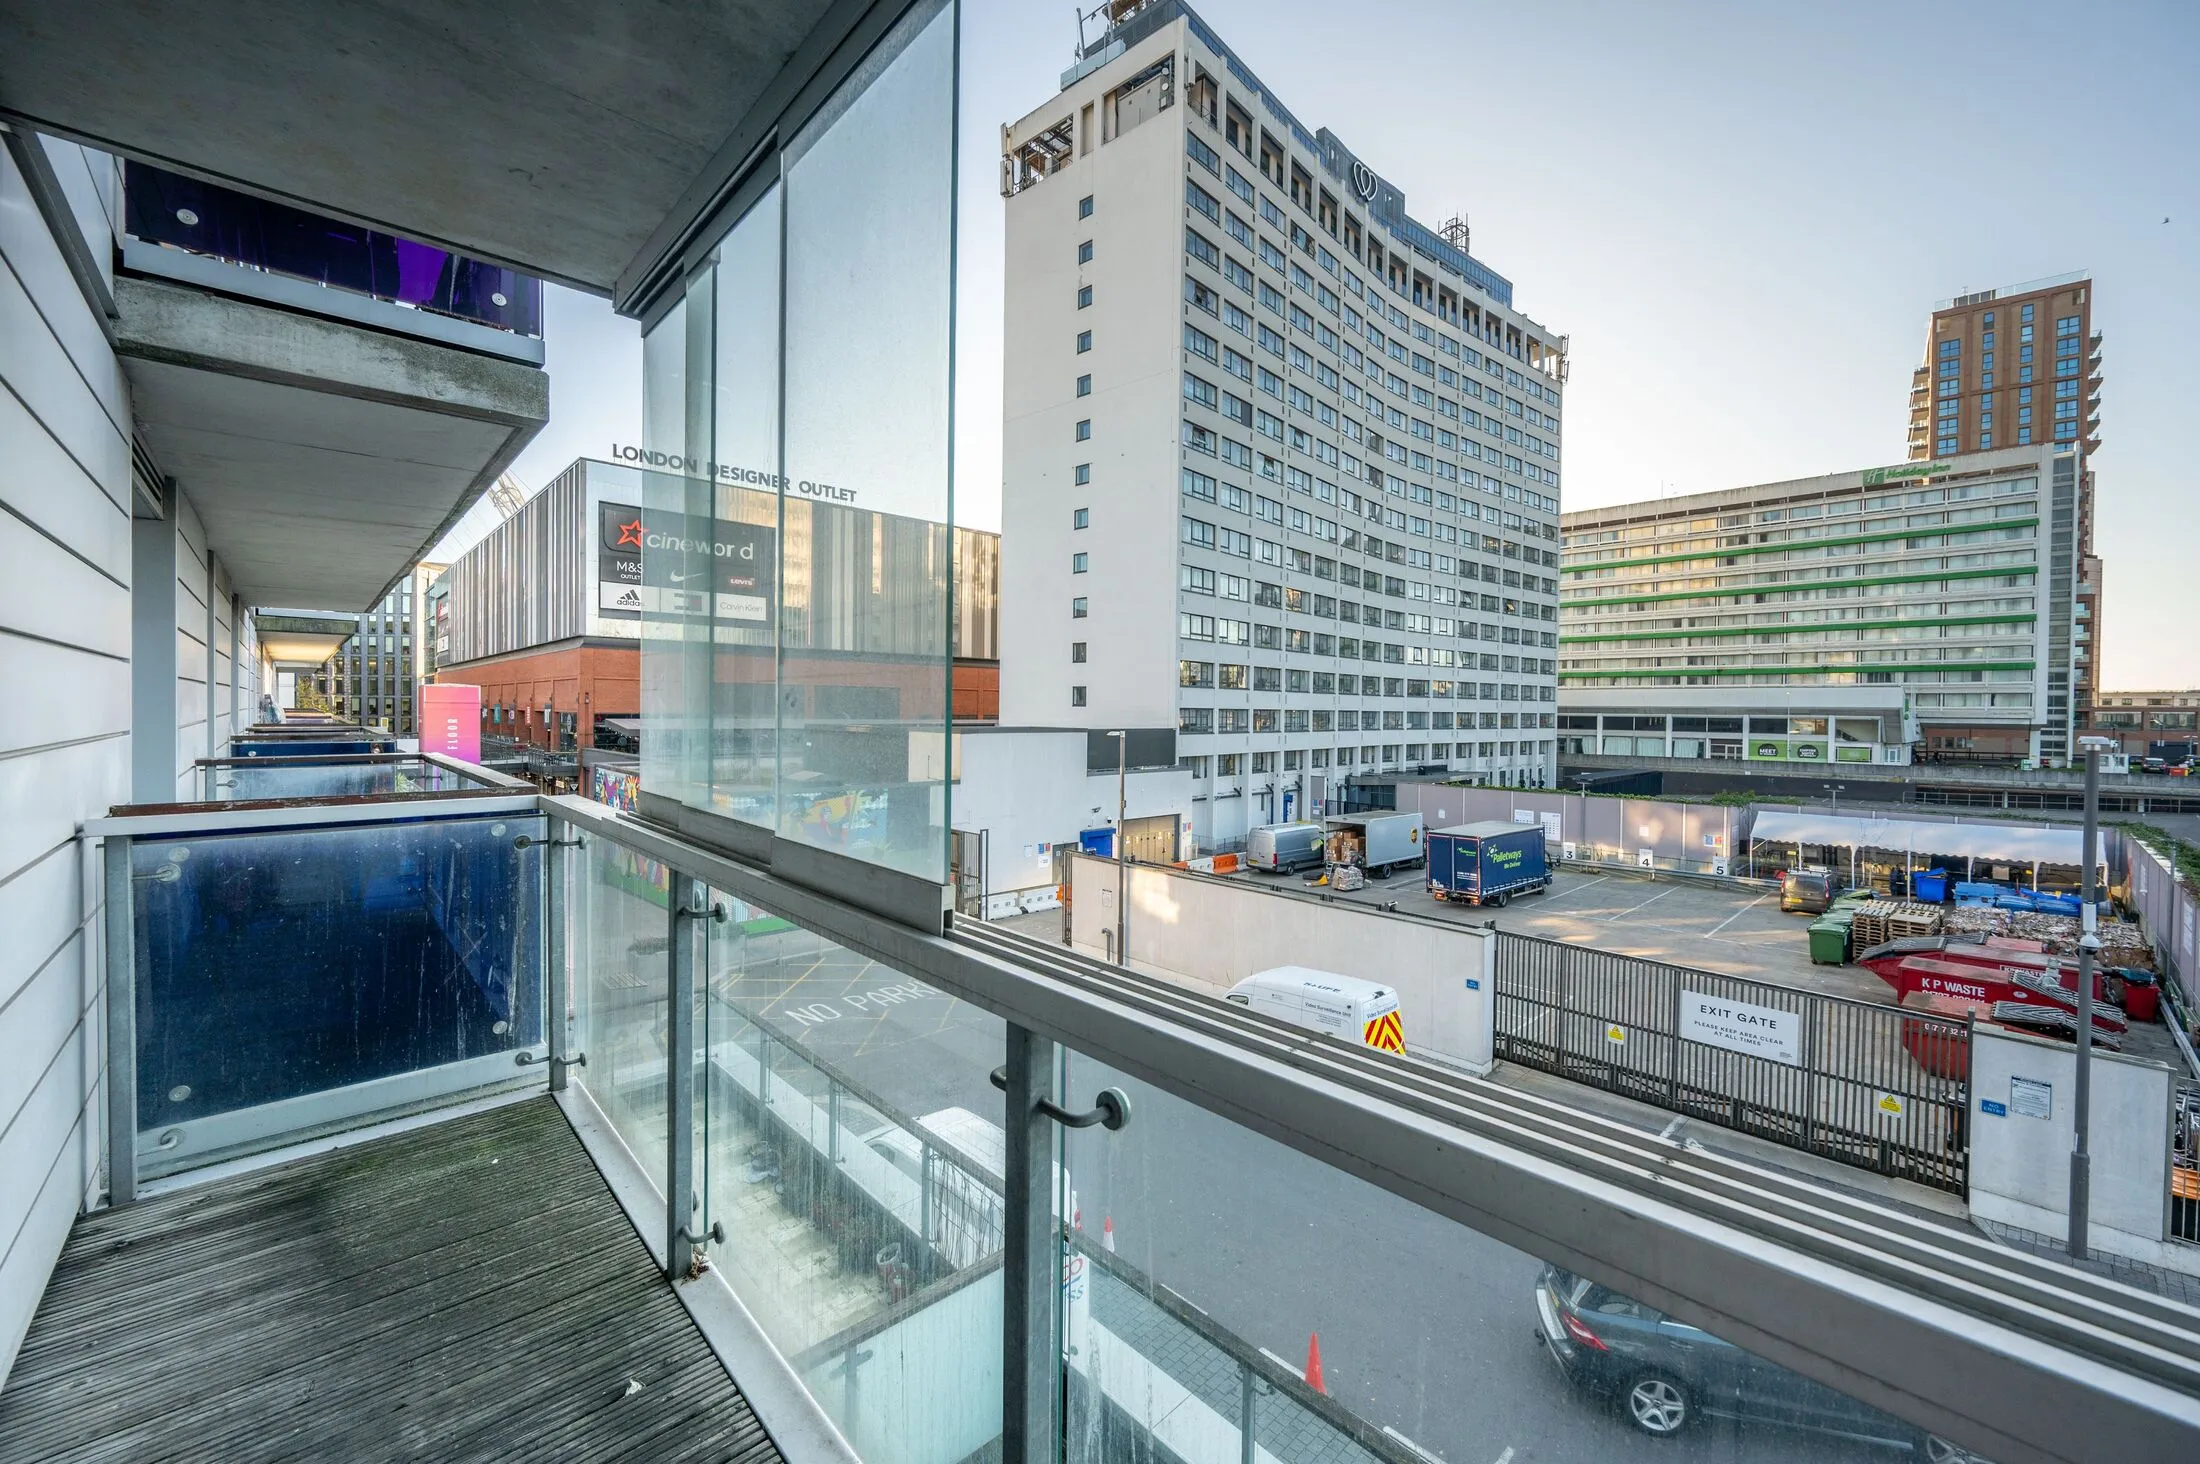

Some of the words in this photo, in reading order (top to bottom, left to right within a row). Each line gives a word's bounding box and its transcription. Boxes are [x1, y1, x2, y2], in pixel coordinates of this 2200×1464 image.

[612, 443, 698, 473] LONDON
[707, 460, 791, 491] DESIGNER
[798, 480, 857, 503] OUTLET
[616, 560, 644, 574] M&S
[1492, 850, 1522, 864] Palletways
[1566, 850, 1573, 859] 3
[1642, 858, 1650, 867] 4
[1716, 866, 1725, 875] 5
[1922, 977, 1930, 988] K
[1933, 979, 1941, 989] P
[1943, 981, 1985, 998] WASTE
[1304, 1001, 1316, 1009] Video
[785, 1003, 843, 1027] NO
[1700, 1004, 1731, 1019] EXIT
[1737, 1013, 1777, 1030] GATE
[1694, 1020, 1718, 1030] PLEASE
[1739, 1031, 1758, 1040] AREA
[1760, 1036, 1784, 1046] CLEAR
[1724, 1033, 1738, 1041] ALL
[1740, 1036, 1761, 1046] TIMES
[1983, 1106, 2005, 1115] ENTRY
